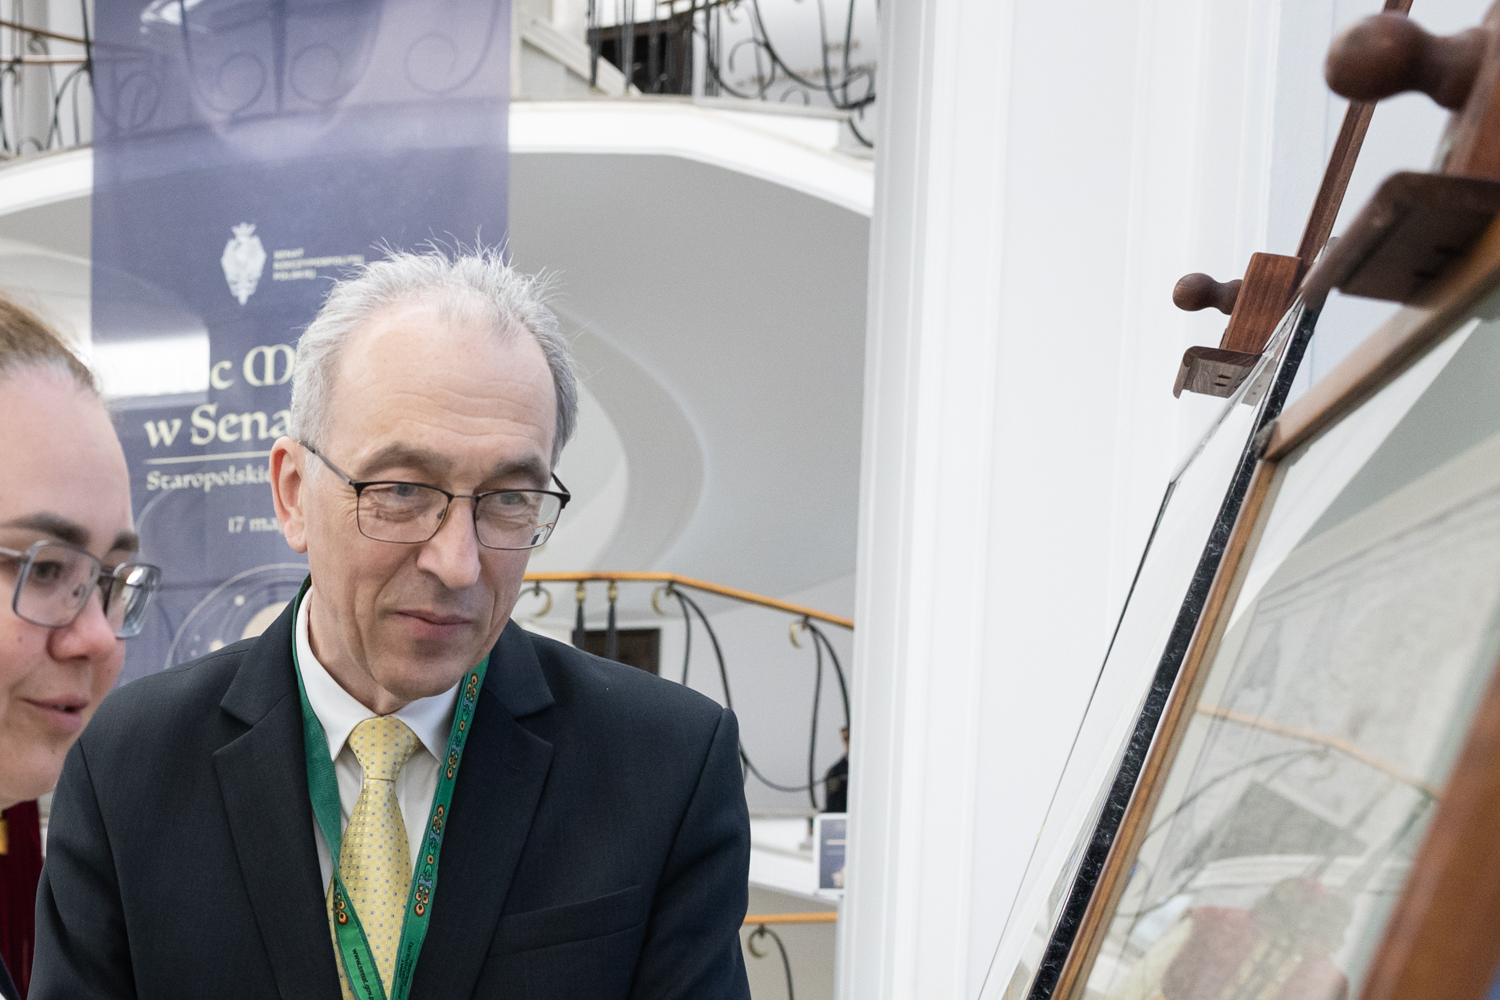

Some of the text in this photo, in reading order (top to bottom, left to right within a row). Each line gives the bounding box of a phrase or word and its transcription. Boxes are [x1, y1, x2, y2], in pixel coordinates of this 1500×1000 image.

[143, 402, 292, 448] w Sena
[228, 516, 246, 534] 17
